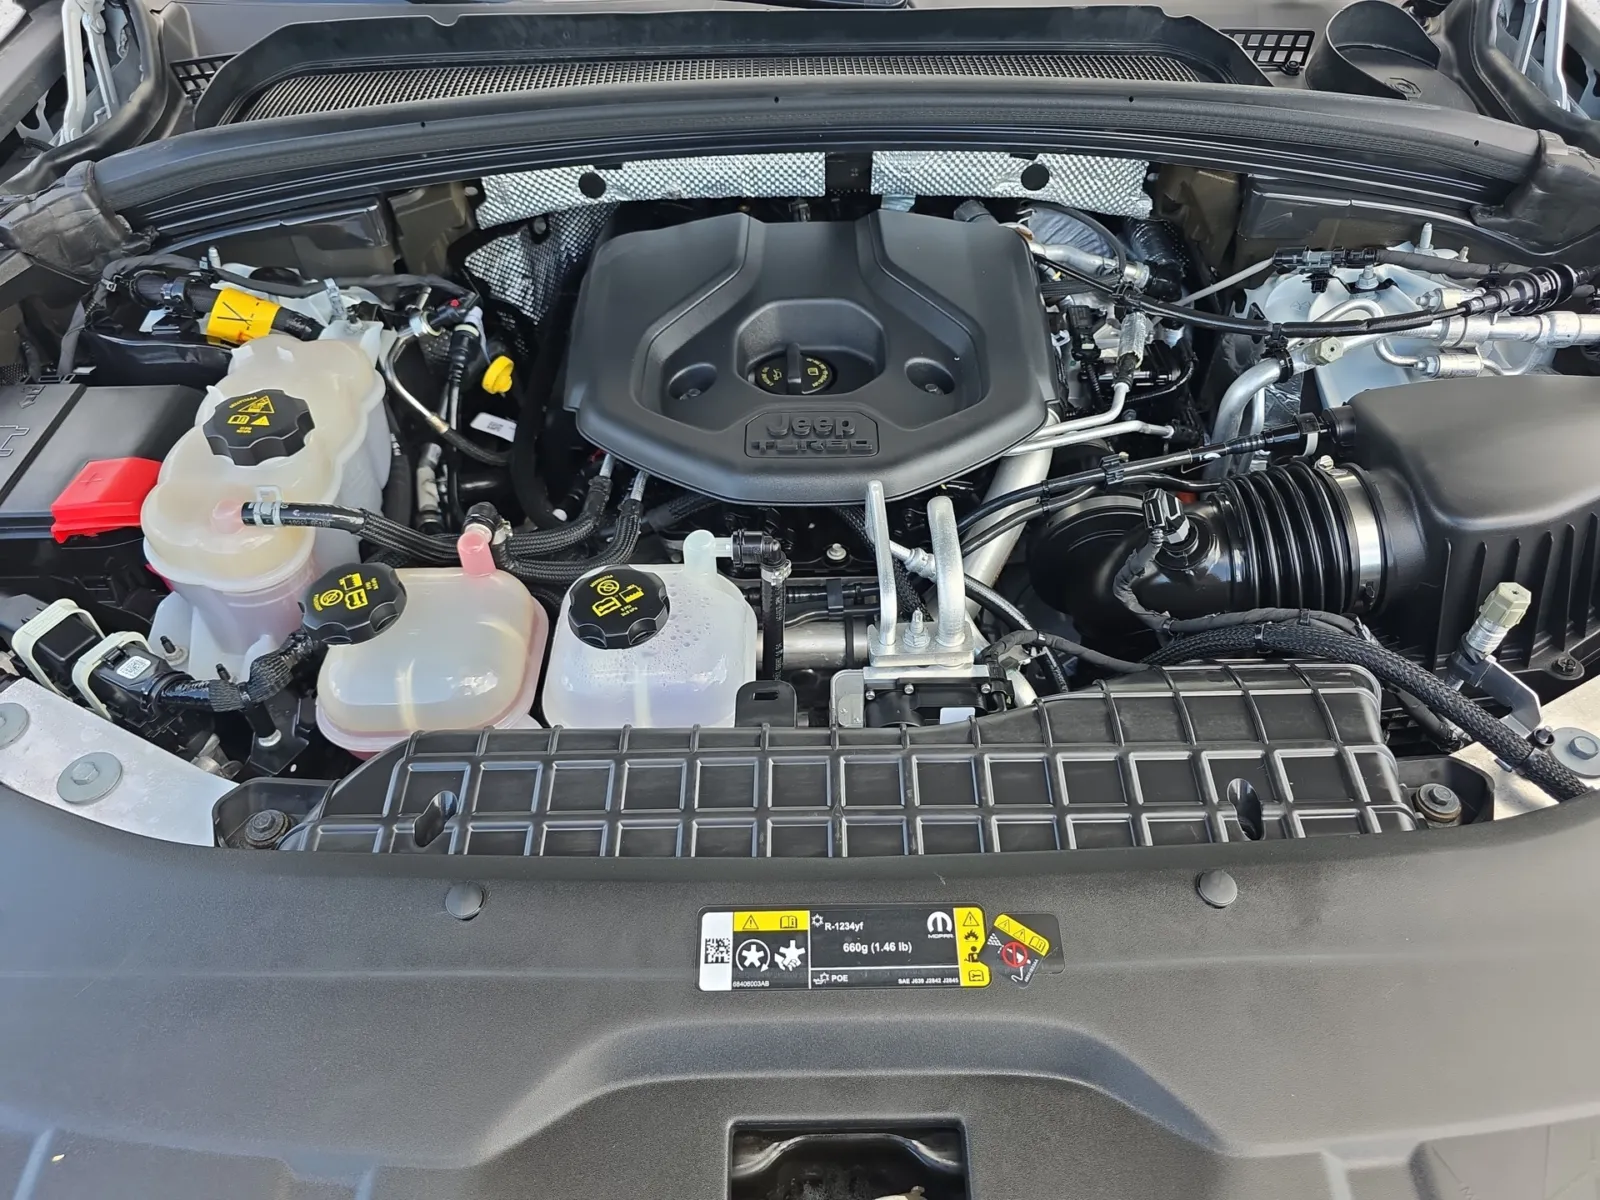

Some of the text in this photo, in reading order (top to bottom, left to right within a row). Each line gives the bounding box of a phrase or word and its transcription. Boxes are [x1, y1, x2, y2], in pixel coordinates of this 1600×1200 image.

[766, 413, 856, 439] Jeep
[824, 921, 864, 932] R-1234yf
[842, 941, 913, 955] 660g (1.46 lb)
[831, 974, 848, 982] POE
